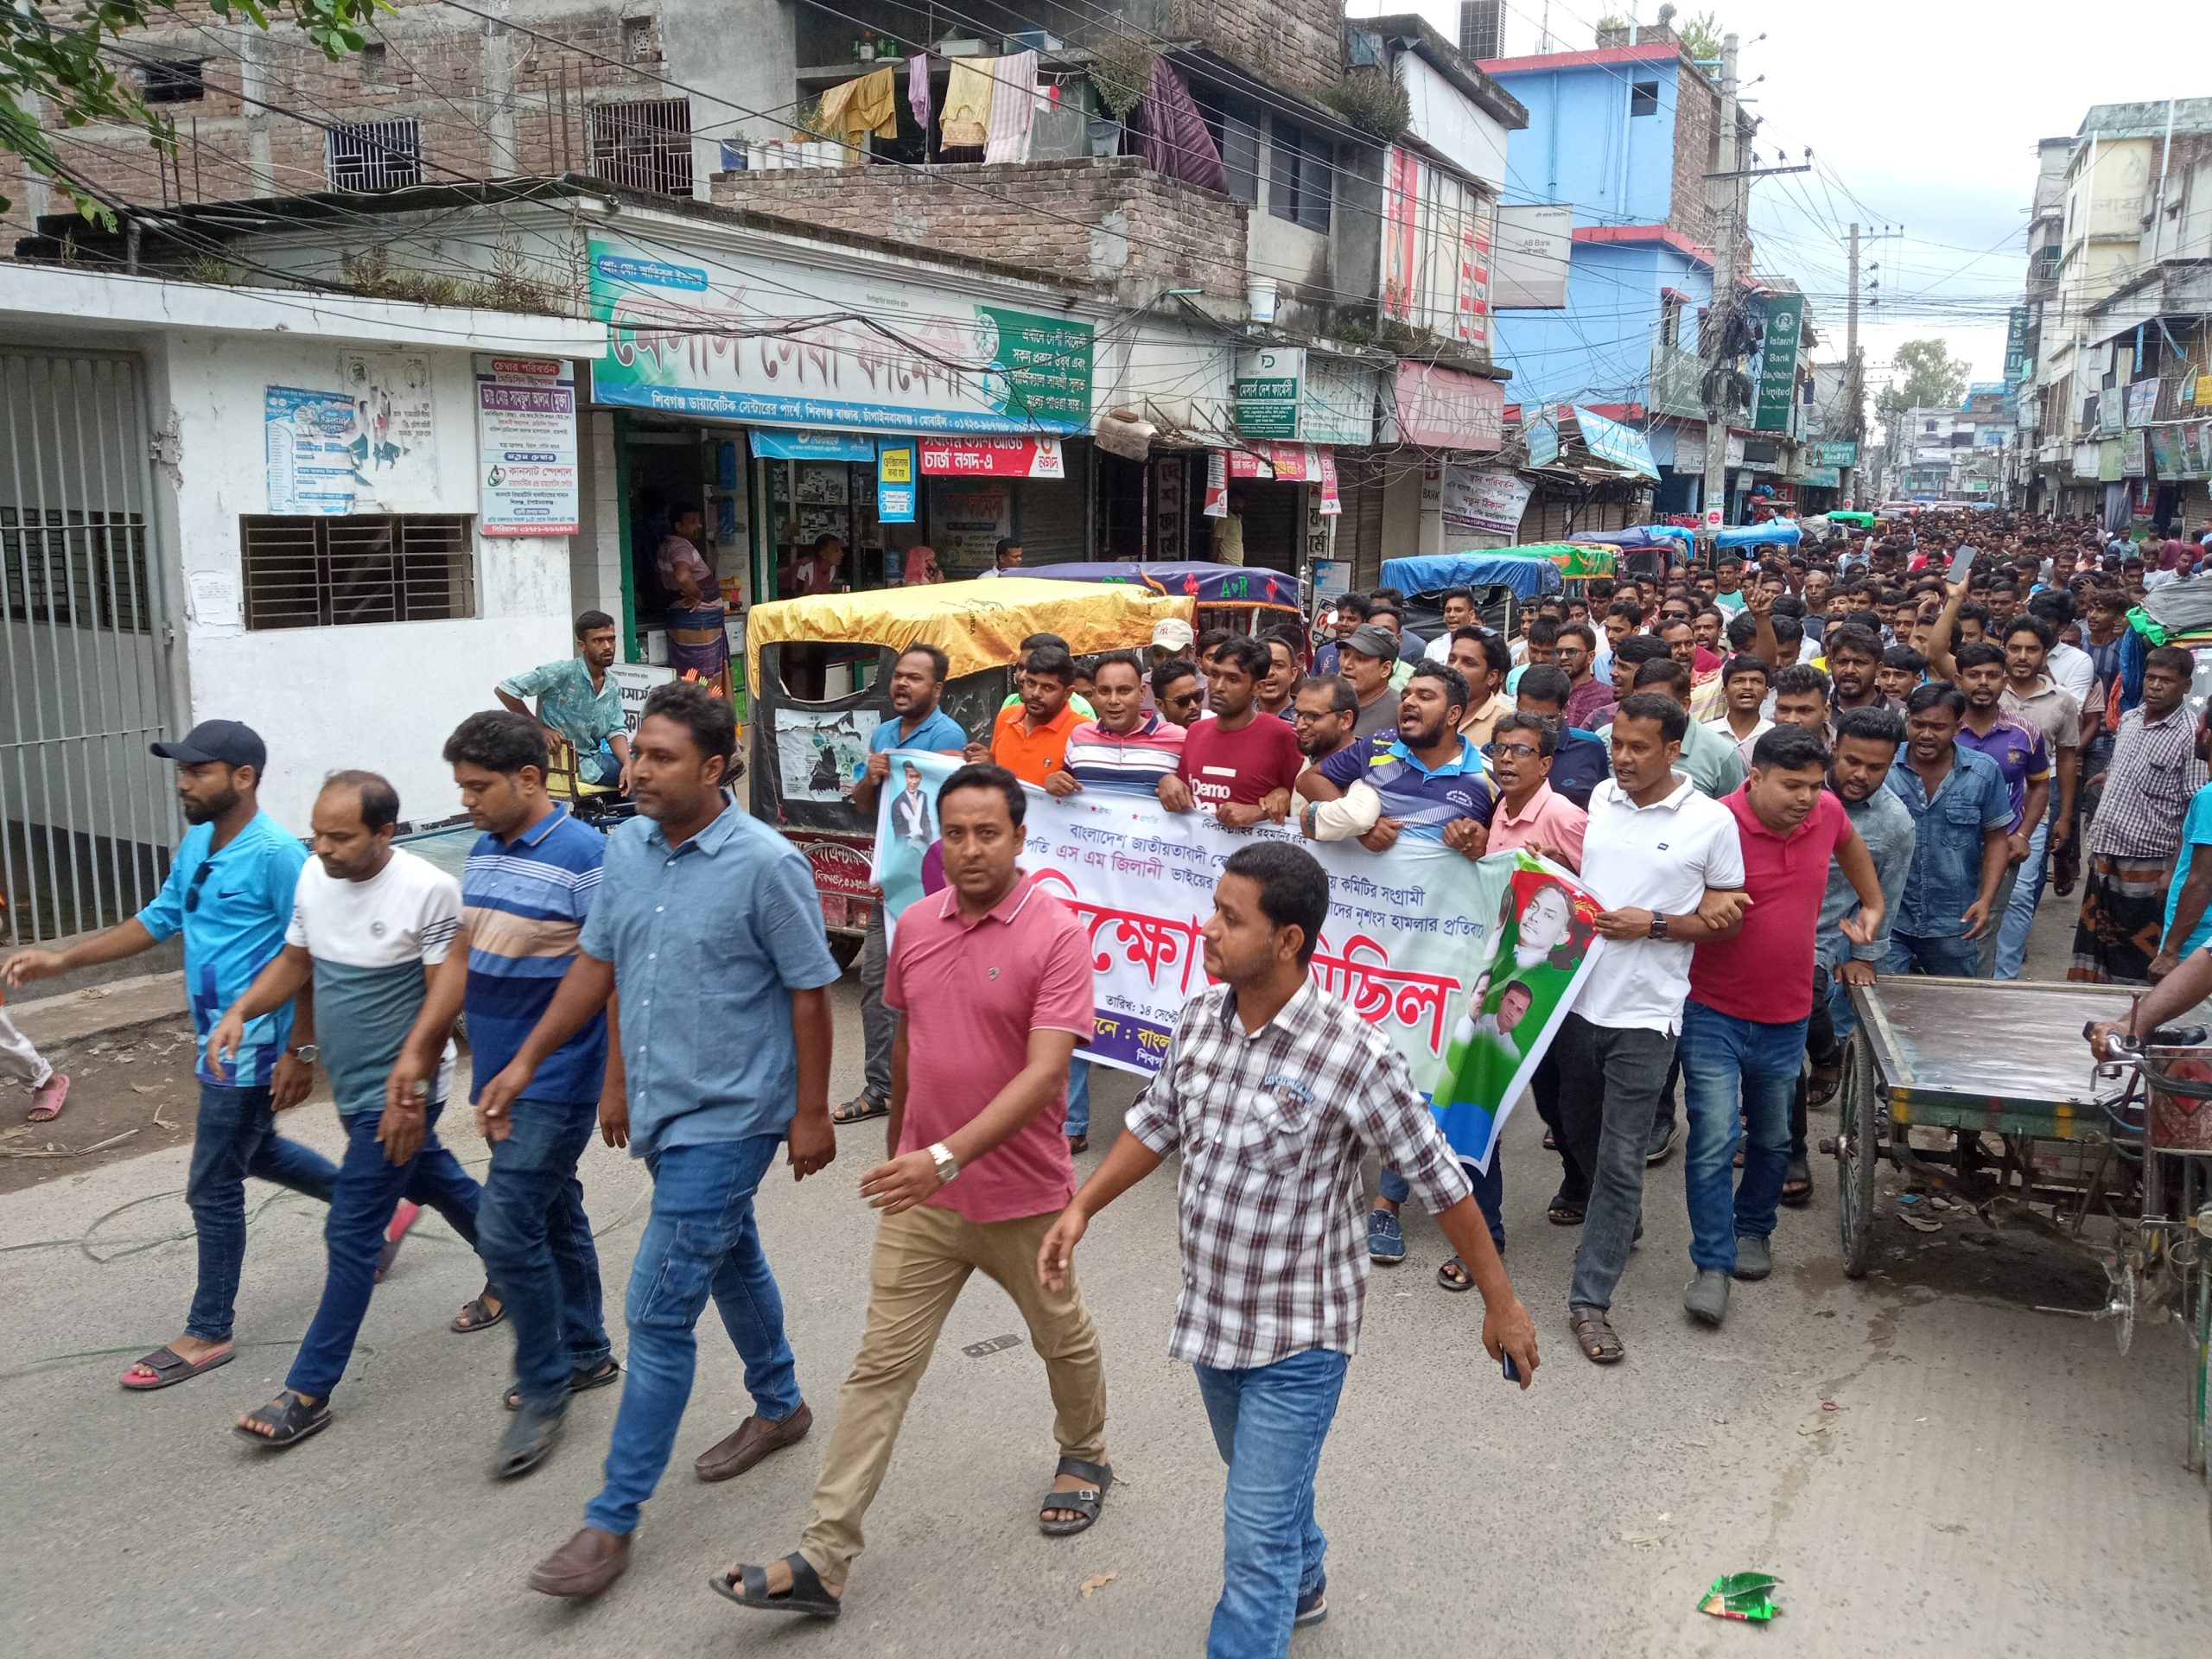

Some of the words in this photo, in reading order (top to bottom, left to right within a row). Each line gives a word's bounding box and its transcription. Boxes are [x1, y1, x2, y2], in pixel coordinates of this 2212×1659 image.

[1770, 336, 1795, 346] Islami
[761, 315, 843, 389] সেবা
[1769, 353, 1789, 363] Bank
[521, 362, 556, 374] পরিবর্তন
[1239, 380, 1258, 397] মেসার্স
[1259, 383, 1270, 397] দেশ
[1761, 386, 1791, 397] Limited
[531, 391, 550, 408] আলম
[652, 391, 686, 410] শিবগঞ্জ
[689, 394, 736, 413] ডায়াবেটিক
[805, 402, 834, 421] শিবগঞ্জ
[919, 414, 948, 429] মোবাইল
[954, 452, 994, 470] নগদ-এ
[1038, 455, 1058, 470] নগদ
[508, 465, 540, 476] কানসাট
[543, 467, 572, 477] স্পেশাল
[1485, 476, 1514, 490] পরিবর্তন
[1422, 487, 1440, 502] BANK
[1463, 496, 1480, 506] নতুন
[1482, 498, 1507, 512] ঠিকানা
[1192, 778, 1231, 799] Demo
[1256, 827, 1291, 842] রহমানির
[1070, 823, 1128, 849] বাংলাদেশ
[1131, 836, 1207, 865] জাতীয়তাবাদী
[1056, 844, 1080, 862] এস
[1084, 851, 1106, 870] এম
[1111, 850, 1165, 880] জিলানী
[1170, 866, 1213, 891] ভাইয়ের
[1340, 875, 1378, 899] কমিটির
[1381, 885, 1427, 907] সংগ্রামী
[1356, 906, 1386, 929] নৃশংস
[1389, 913, 1440, 933] হামলার
[1106, 995, 1135, 1012] তারিখ:
[1140, 1004, 1152, 1016] ১৪
